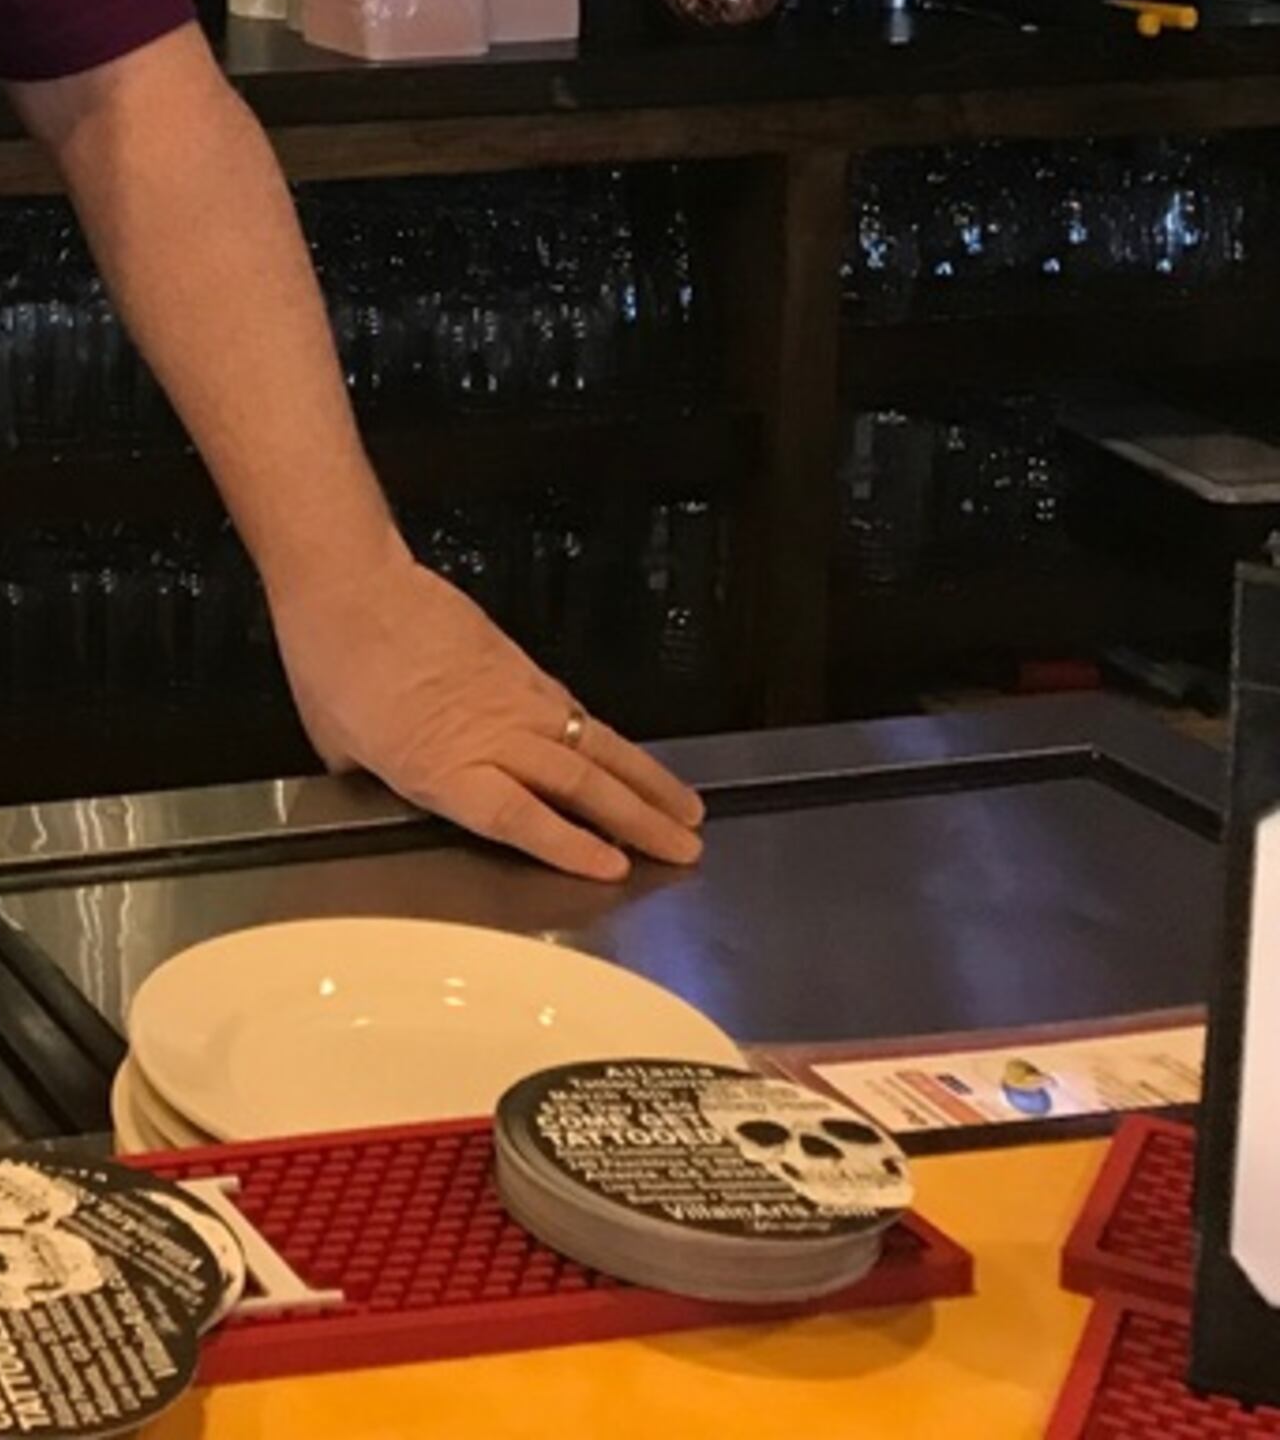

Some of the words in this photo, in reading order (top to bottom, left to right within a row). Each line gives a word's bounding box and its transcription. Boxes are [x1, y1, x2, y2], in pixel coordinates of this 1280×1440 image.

[606, 1065, 715, 1079] Atlanta
[535, 1113, 630, 1130] COME
[638, 1113, 709, 1128] GET
[540, 1129, 729, 1148] TATTOOED
